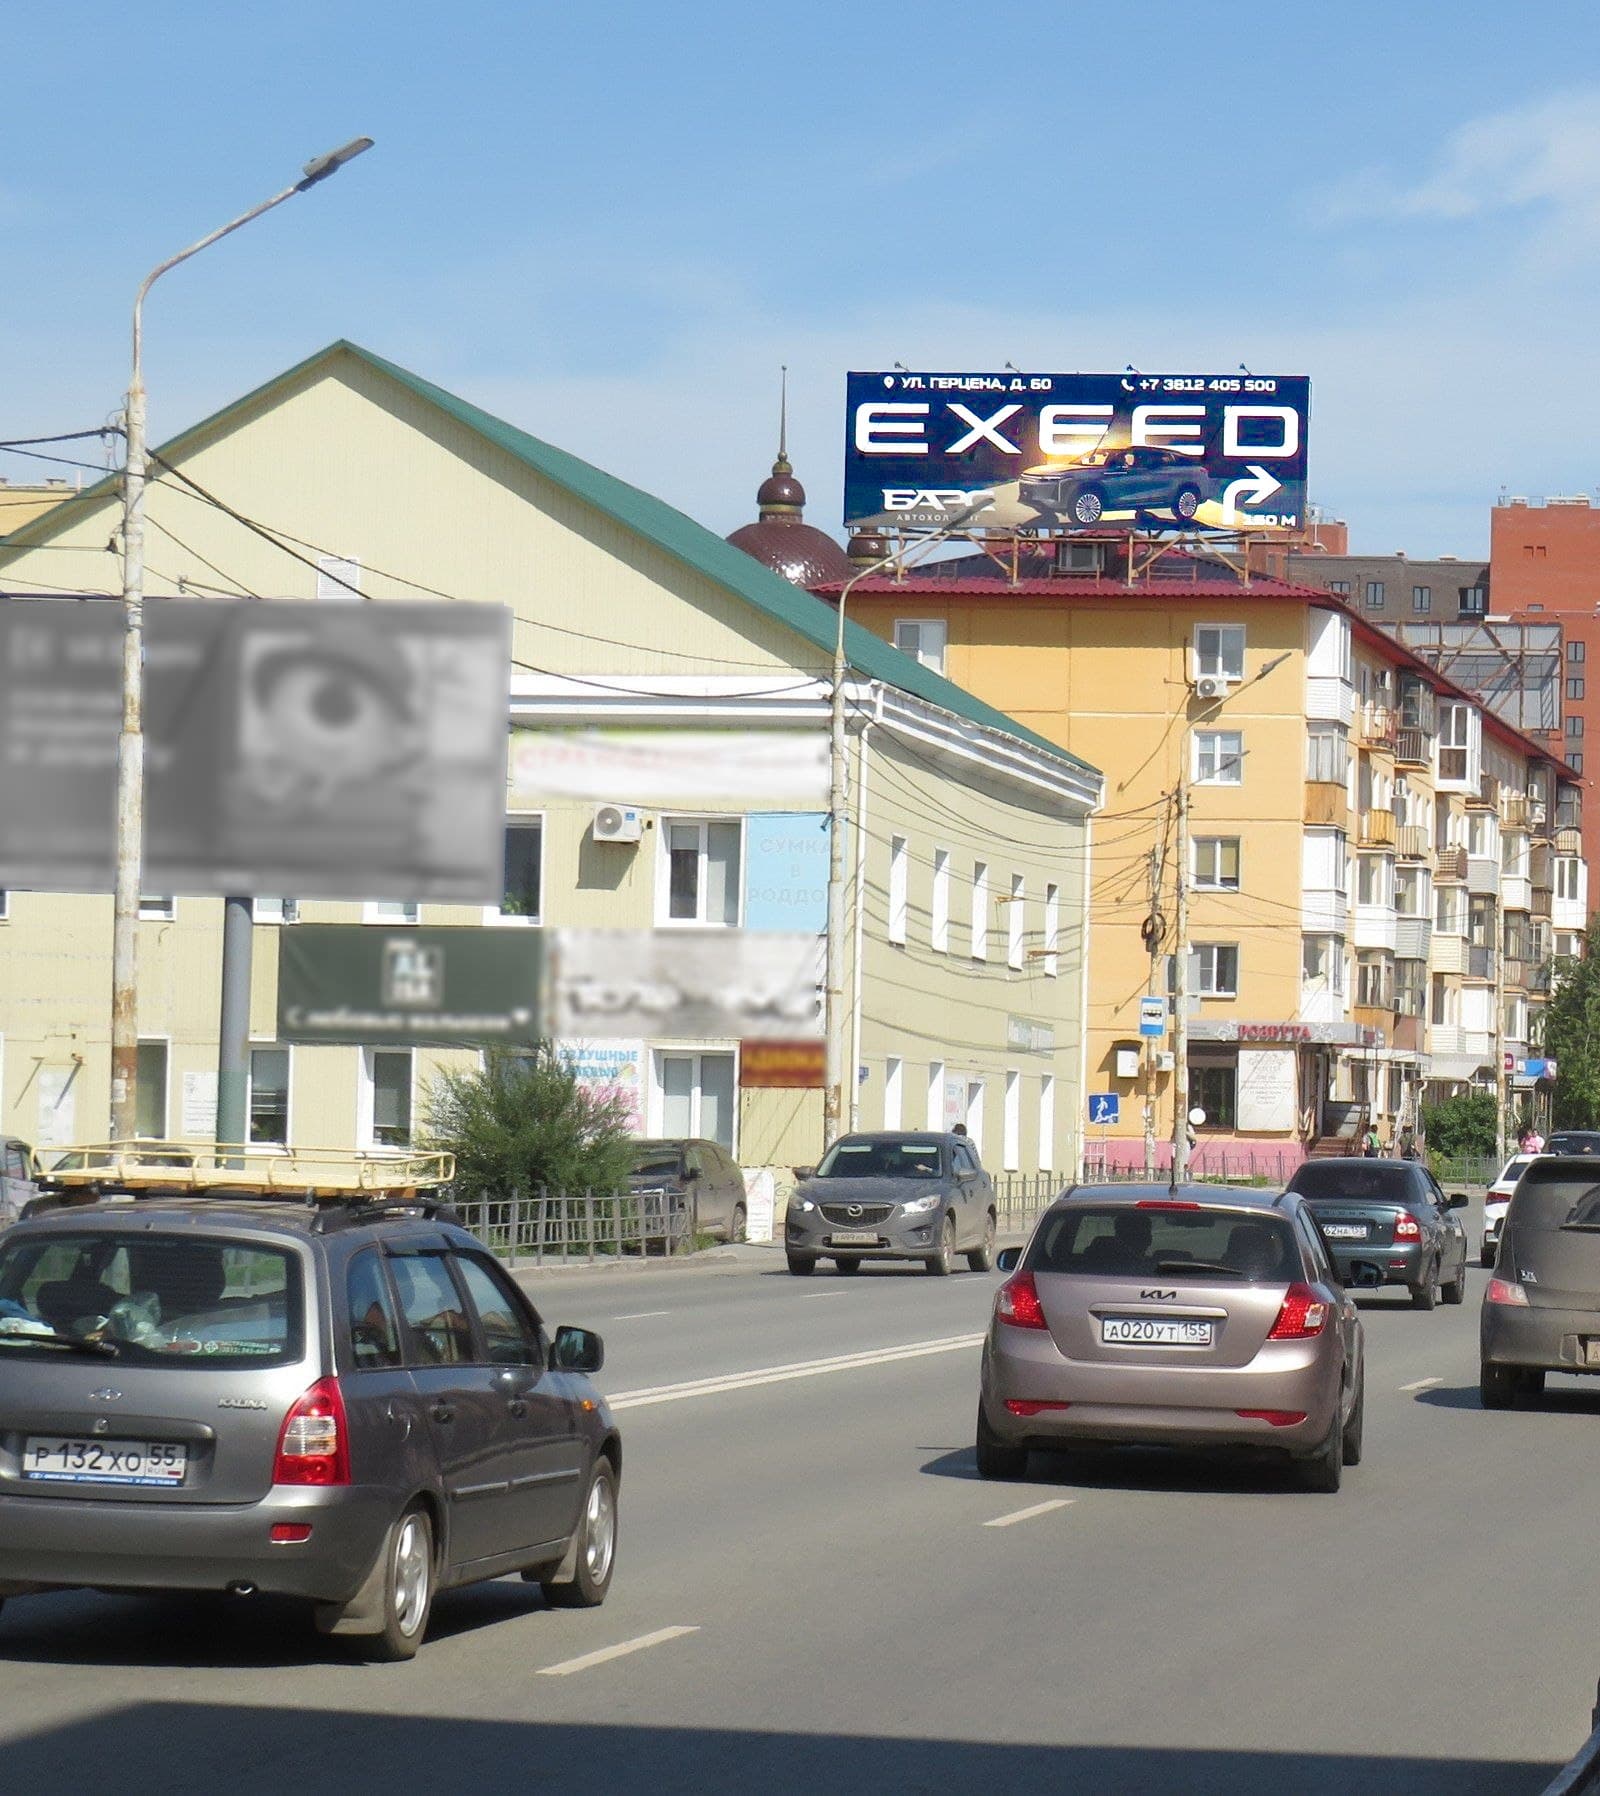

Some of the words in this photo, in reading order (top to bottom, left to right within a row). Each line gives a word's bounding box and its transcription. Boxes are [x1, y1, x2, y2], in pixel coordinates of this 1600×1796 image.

[900, 376, 926, 389] УЛ.
[930, 377, 1006, 392] ГЕРЦЕНА,
[1010, 378, 1027, 391] Д.
[1030, 378, 1052, 390] 60
[1139, 379, 1160, 390] +7
[1163, 379, 1205, 391] 3812
[1208, 379, 1241, 391] 405
[1244, 380, 1276, 392] 500
[854, 402, 1299, 457] EXEED
[1109, 1321, 1177, 1340] А020УТ
[1181, 1322, 1207, 1337] 155
[218, 1398, 268, 1409] KALINA
[34, 1442, 141, 1472] Р132ХО
[150, 1445, 176, 1467] 55
